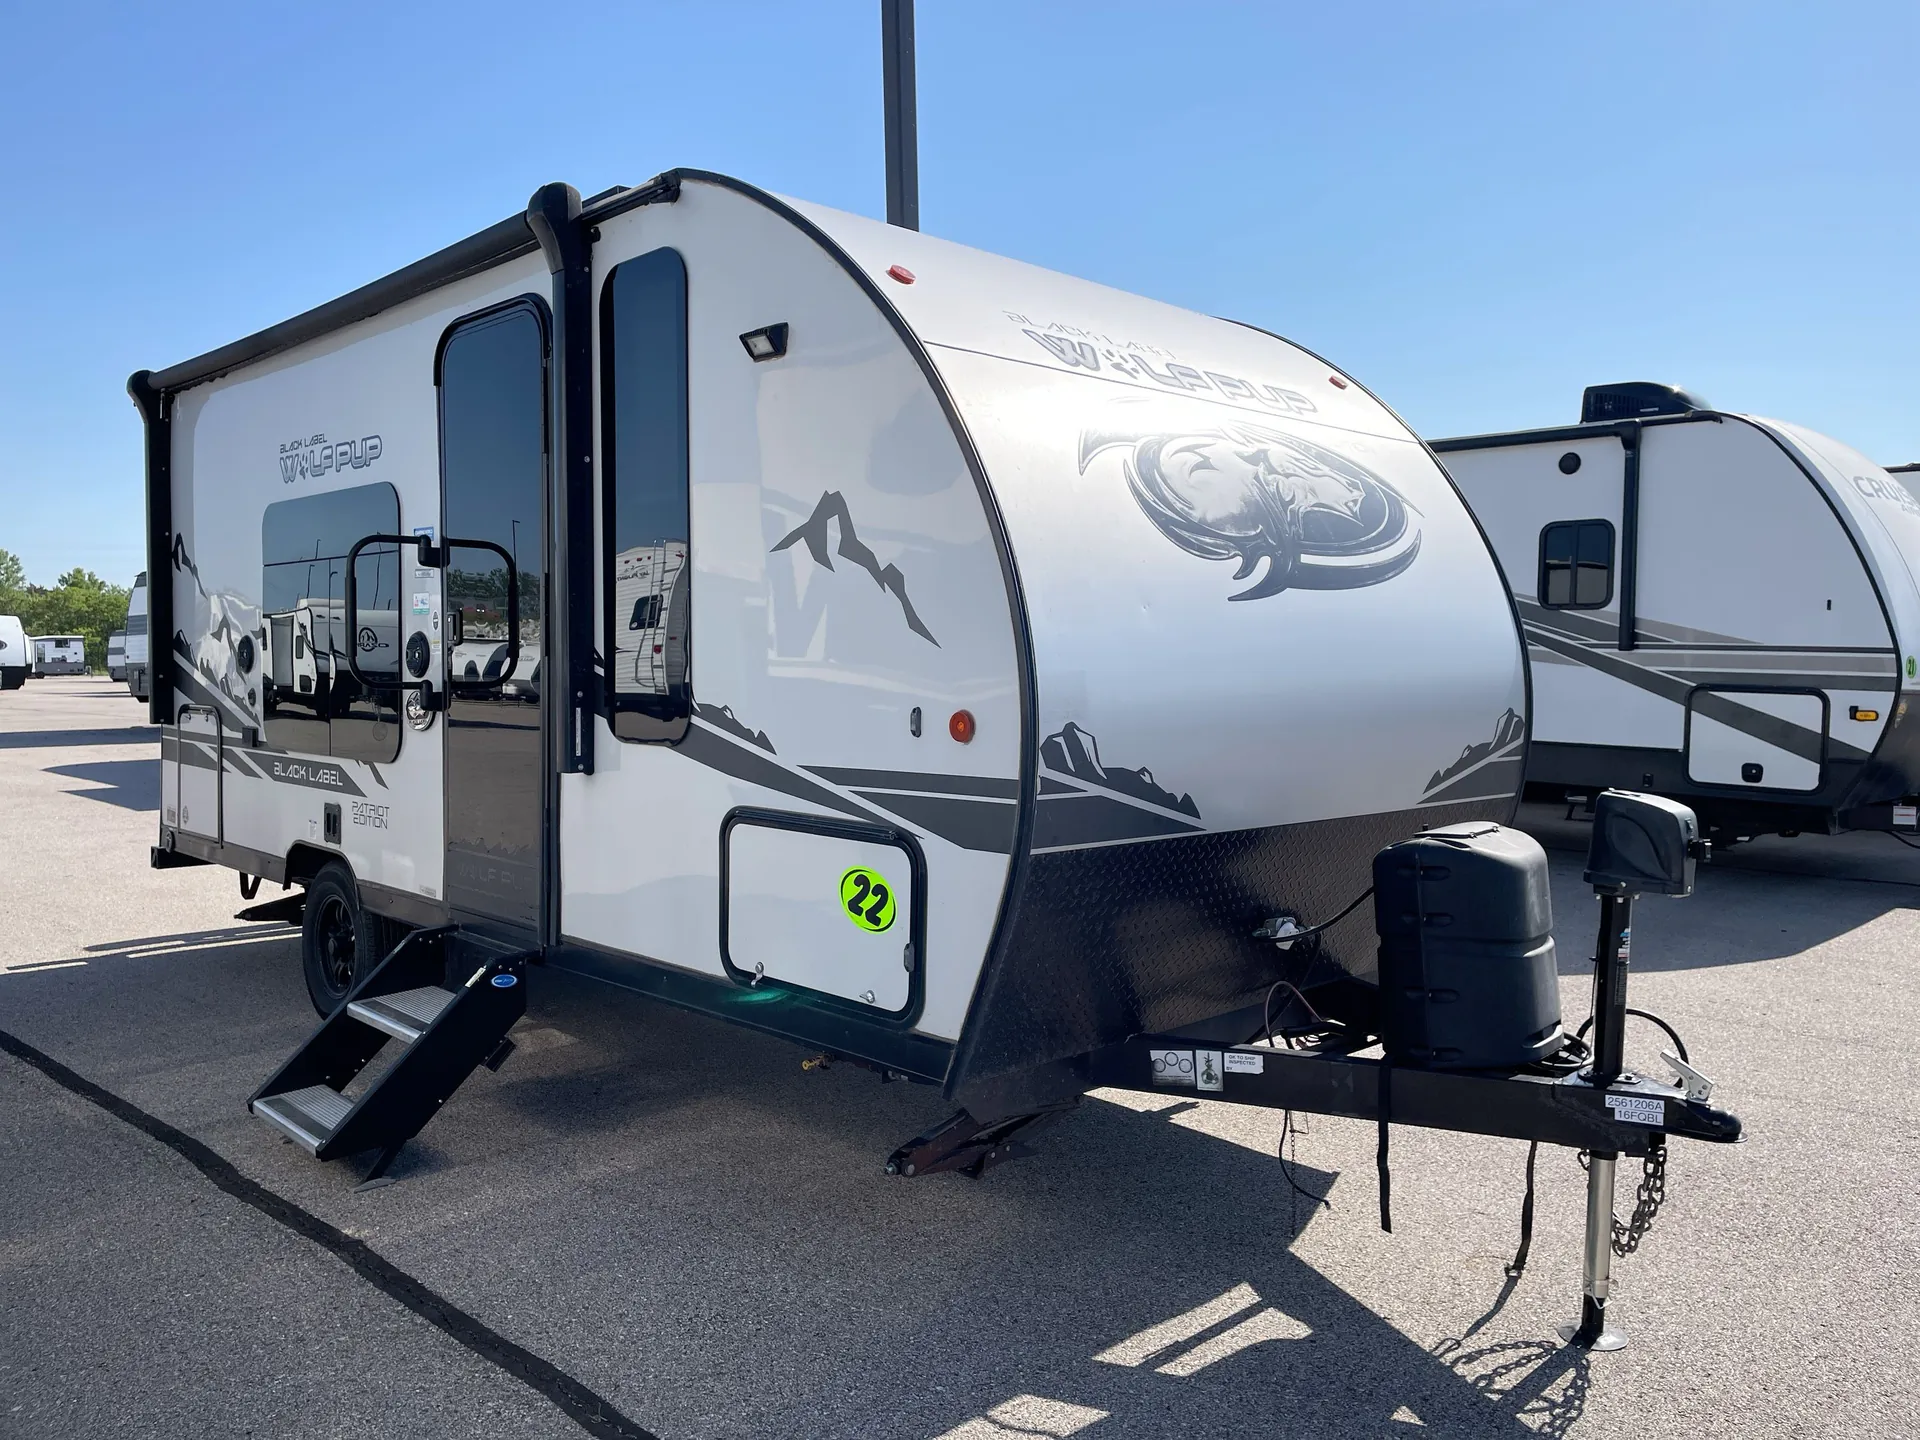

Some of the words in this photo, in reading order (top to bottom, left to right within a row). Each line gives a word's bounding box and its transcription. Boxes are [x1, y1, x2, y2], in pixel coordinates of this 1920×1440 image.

[1203, 370, 1319, 415] PUP
[280, 439, 303, 454] BLACK
[304, 433, 328, 448] LABEL
[335, 434, 383, 473] PUP
[273, 761, 307, 779] BLACK
[308, 766, 344, 786] LABEL
[351, 800, 390, 818] PATRIOT
[352, 812, 388, 830] EDITION
[847, 873, 889, 927] 22
[1607, 1096, 1663, 1111] 2561206A
[1617, 1109, 1662, 1124] 16FQBL
